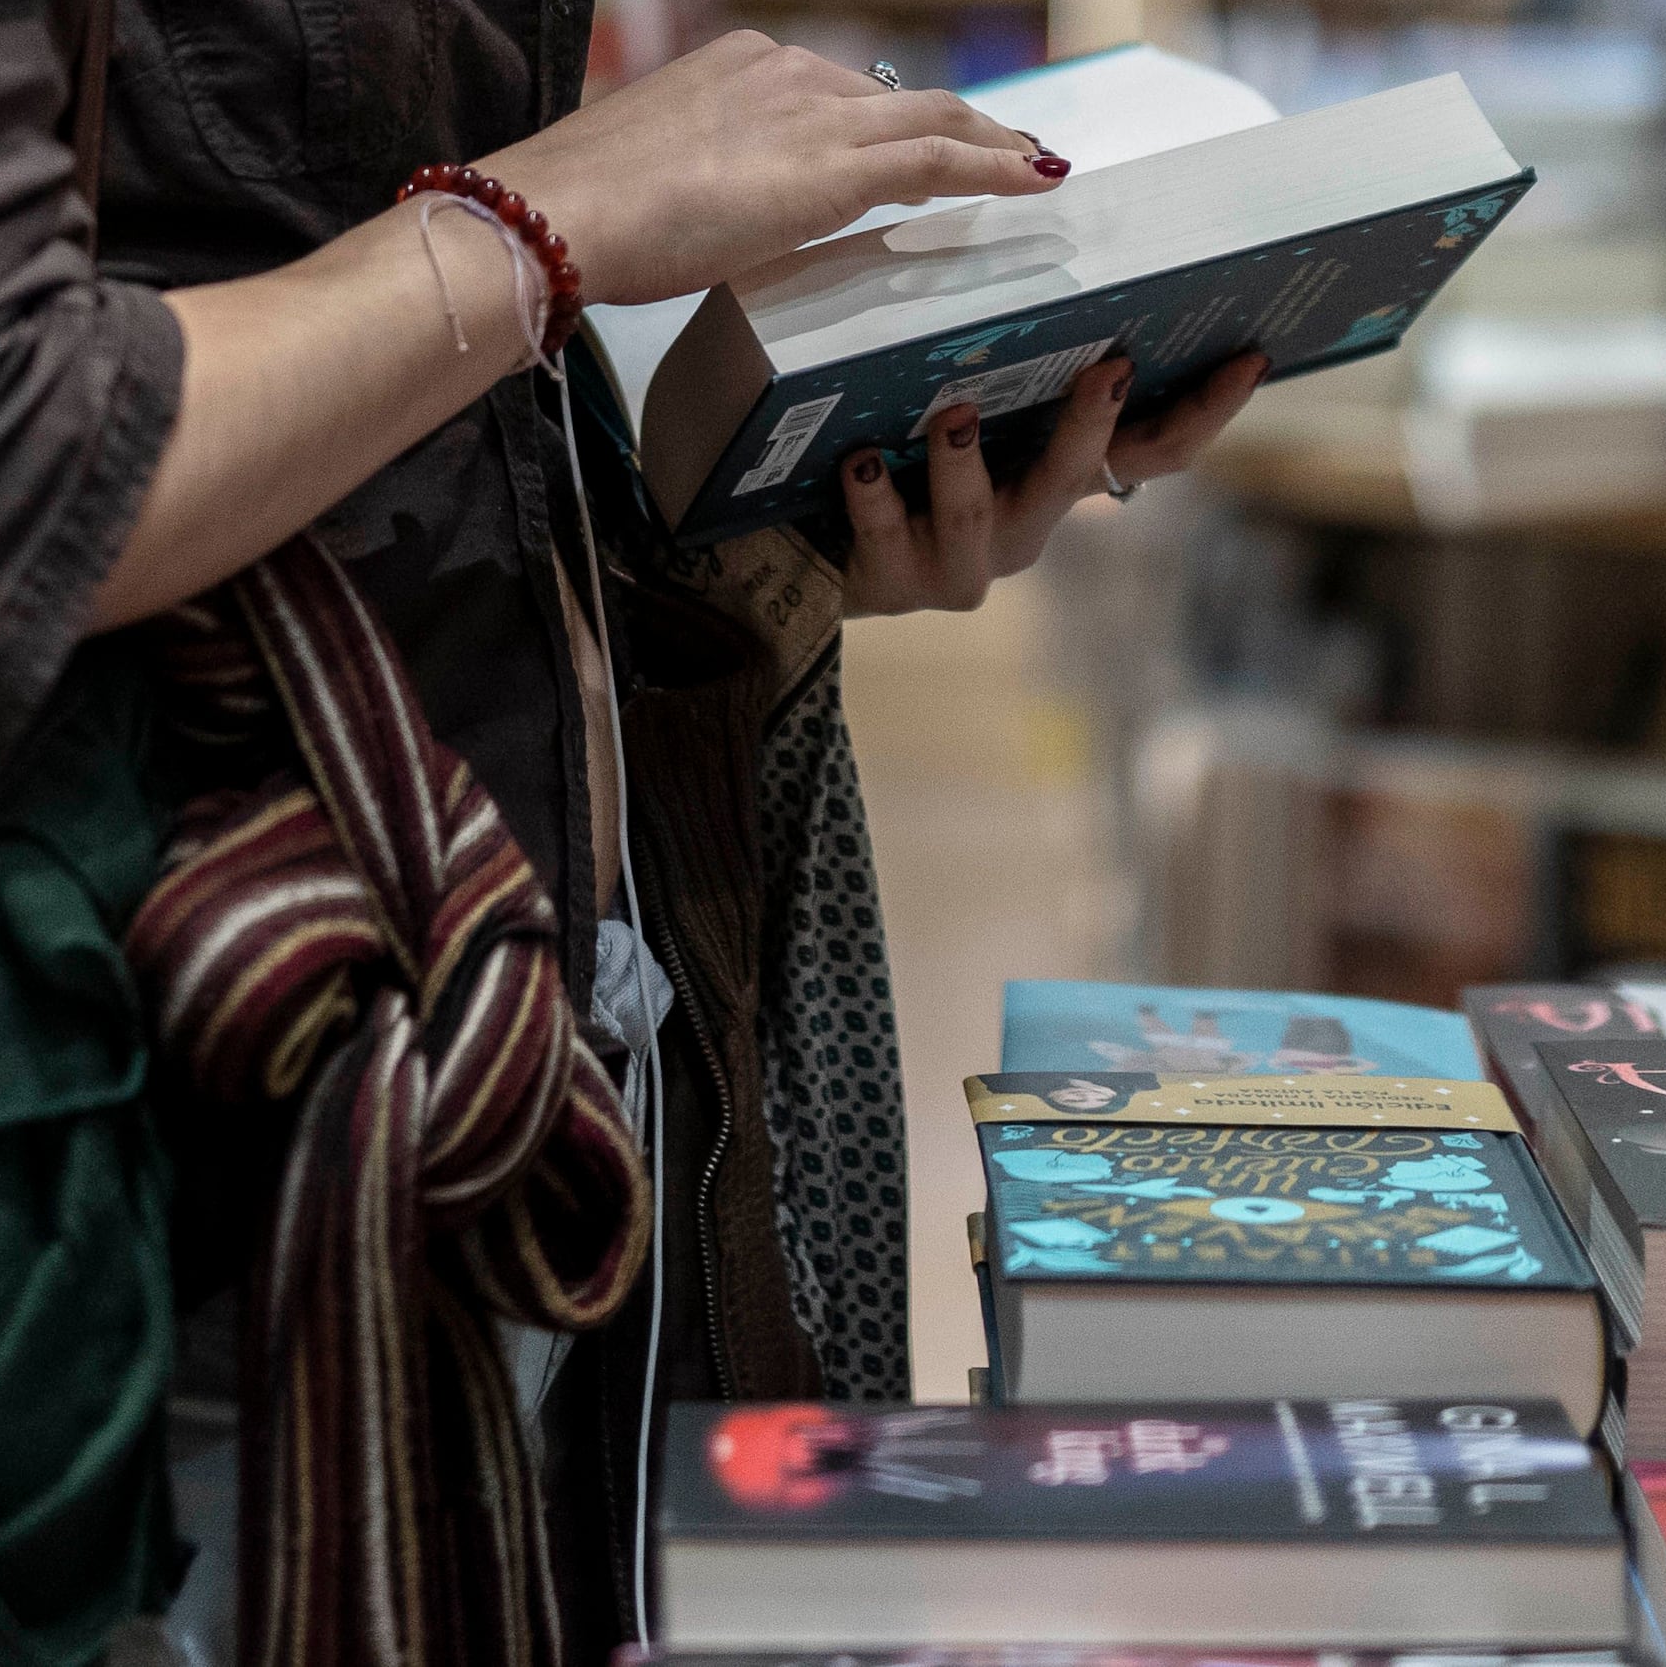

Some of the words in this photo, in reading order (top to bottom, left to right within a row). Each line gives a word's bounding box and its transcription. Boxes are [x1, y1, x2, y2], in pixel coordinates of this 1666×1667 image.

[1192, 1098, 1325, 1110] limitada
[1334, 1100, 1453, 1111] Edición
[1031, 1126, 1436, 1157] Perfecto
[1119, 1154, 1381, 1176] Cuento
[1208, 1169, 1299, 1193] Un
